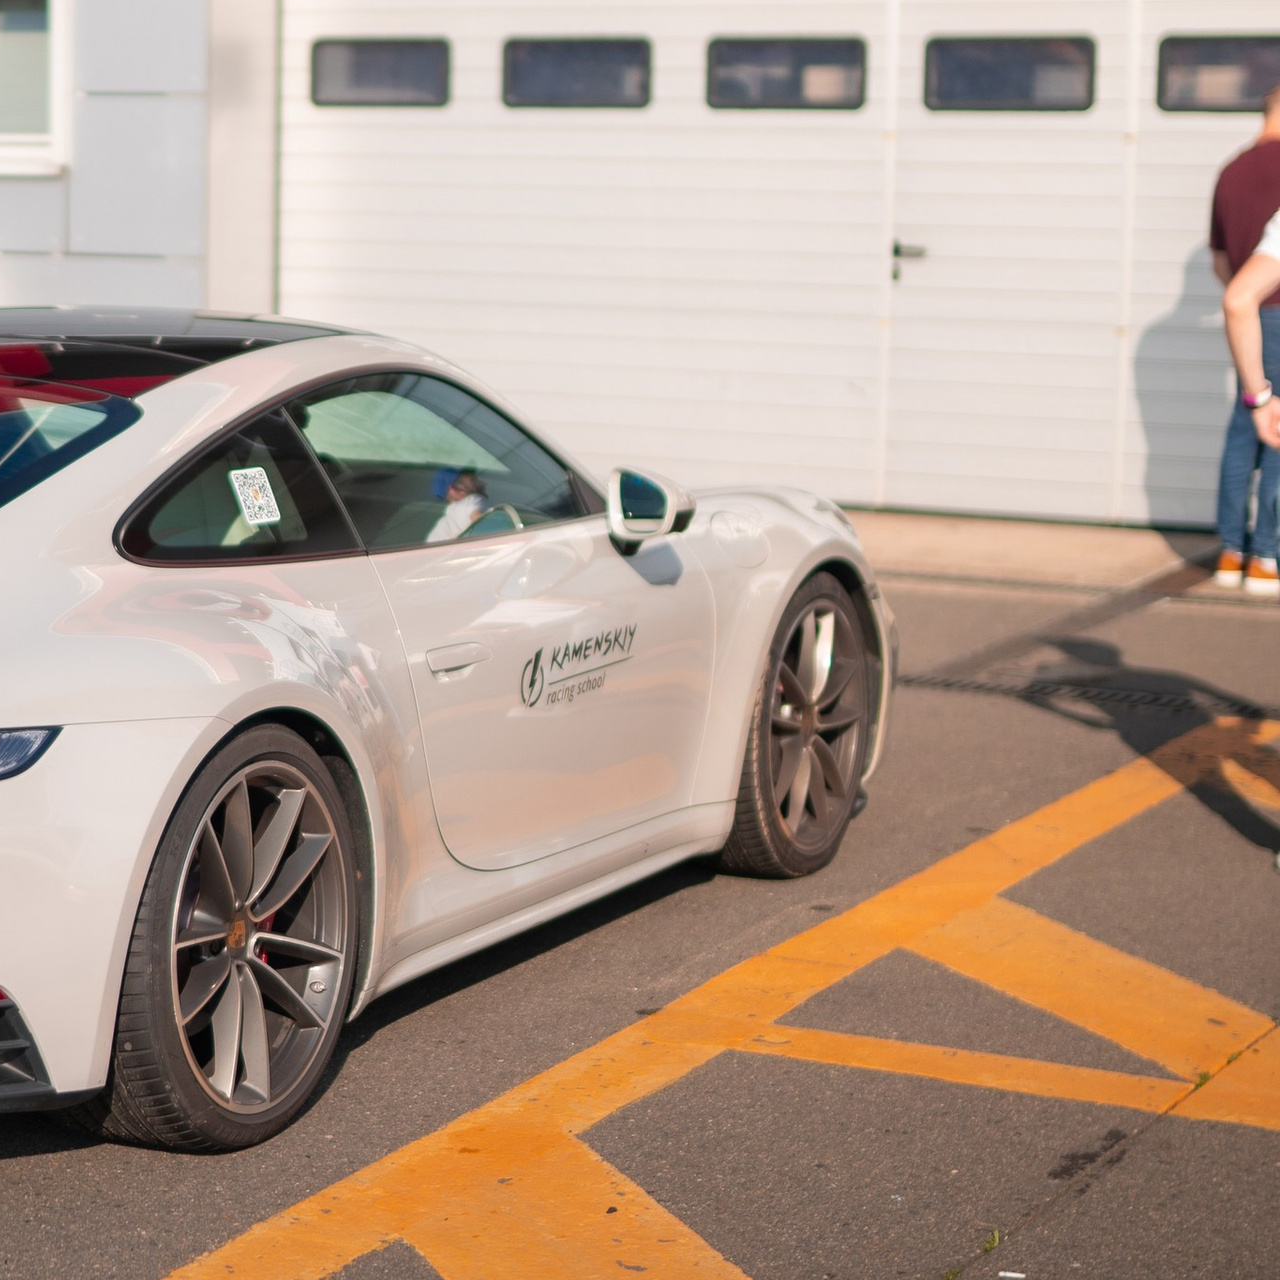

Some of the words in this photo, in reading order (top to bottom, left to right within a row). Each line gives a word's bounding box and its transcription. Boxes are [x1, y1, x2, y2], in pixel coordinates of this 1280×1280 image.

[550, 622, 637, 671] KAMENSKIY
[546, 683, 575, 706] racing
[577, 671, 606, 695] school
